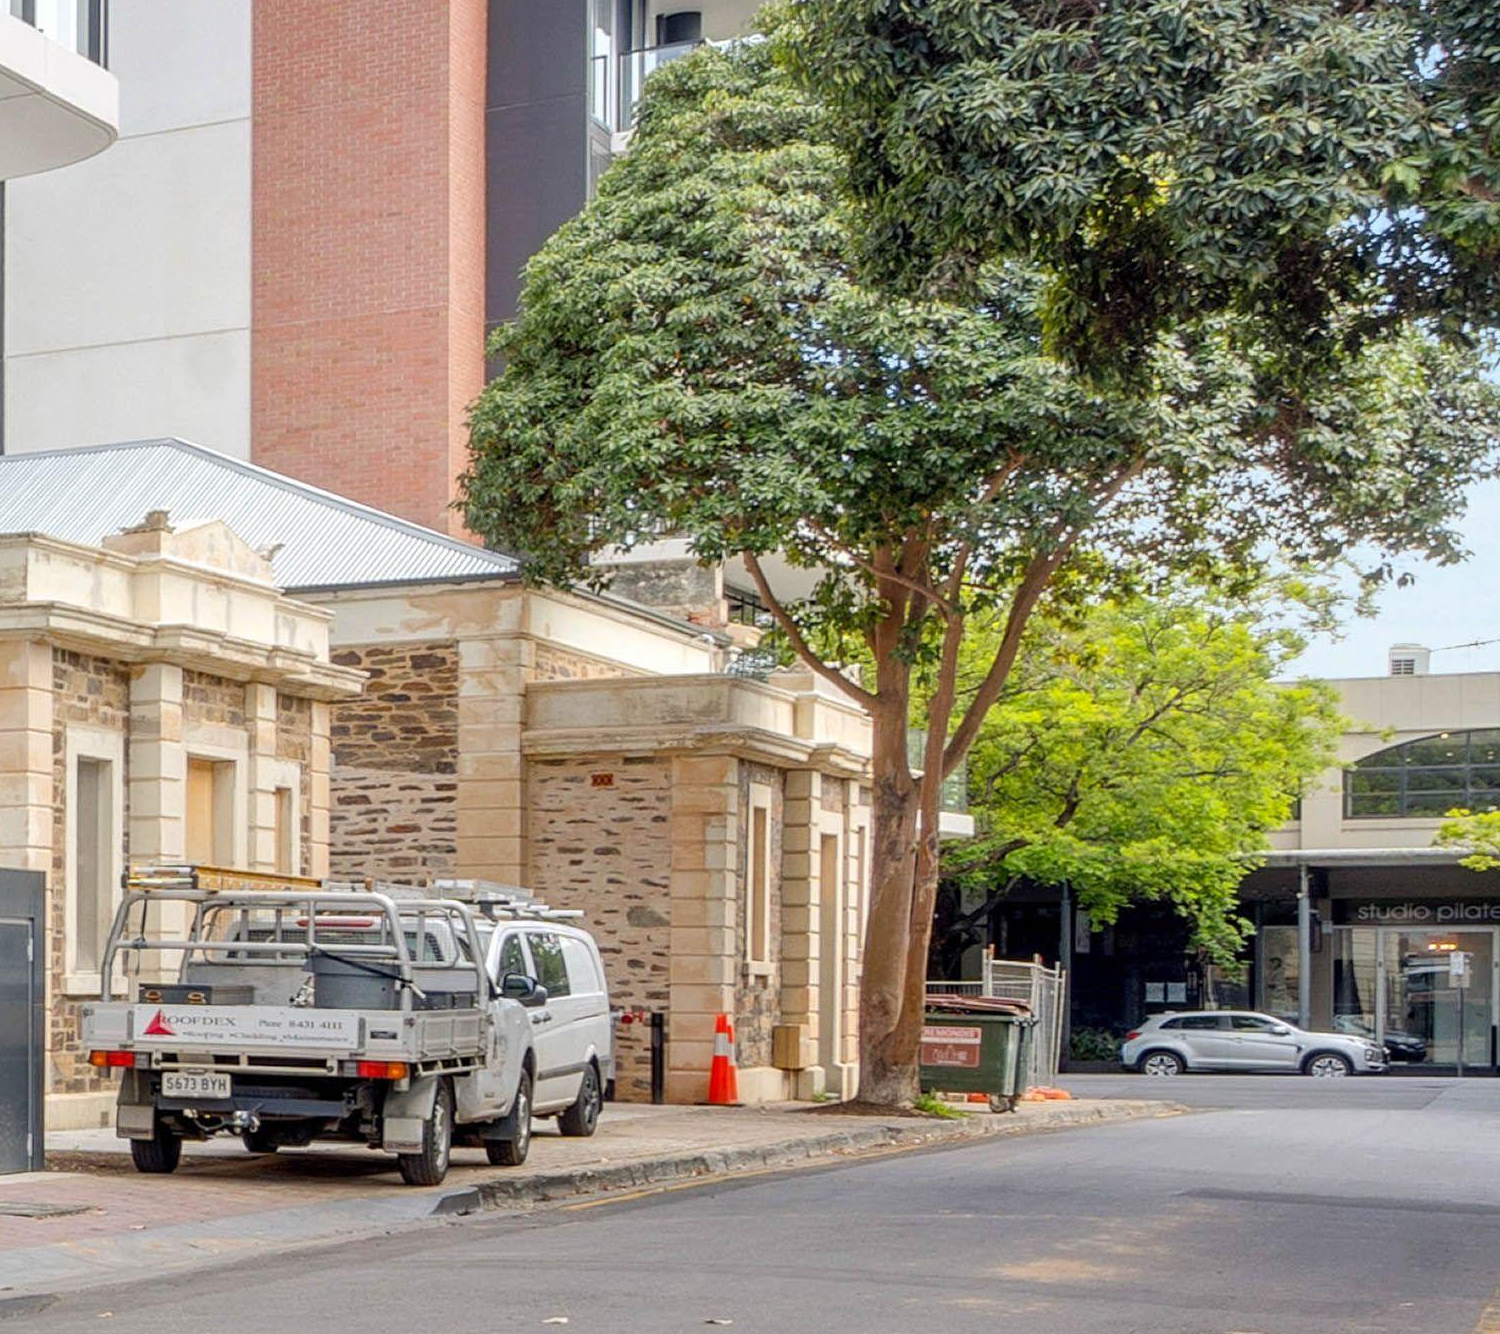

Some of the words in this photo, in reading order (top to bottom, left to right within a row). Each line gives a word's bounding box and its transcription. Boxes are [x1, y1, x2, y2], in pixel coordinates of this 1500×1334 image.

[1358, 903, 1430, 920] studio
[159, 1014, 236, 1027] ROOFDEX
[166, 1077, 197, 1091] S673
[201, 1078, 227, 1092] BYH
